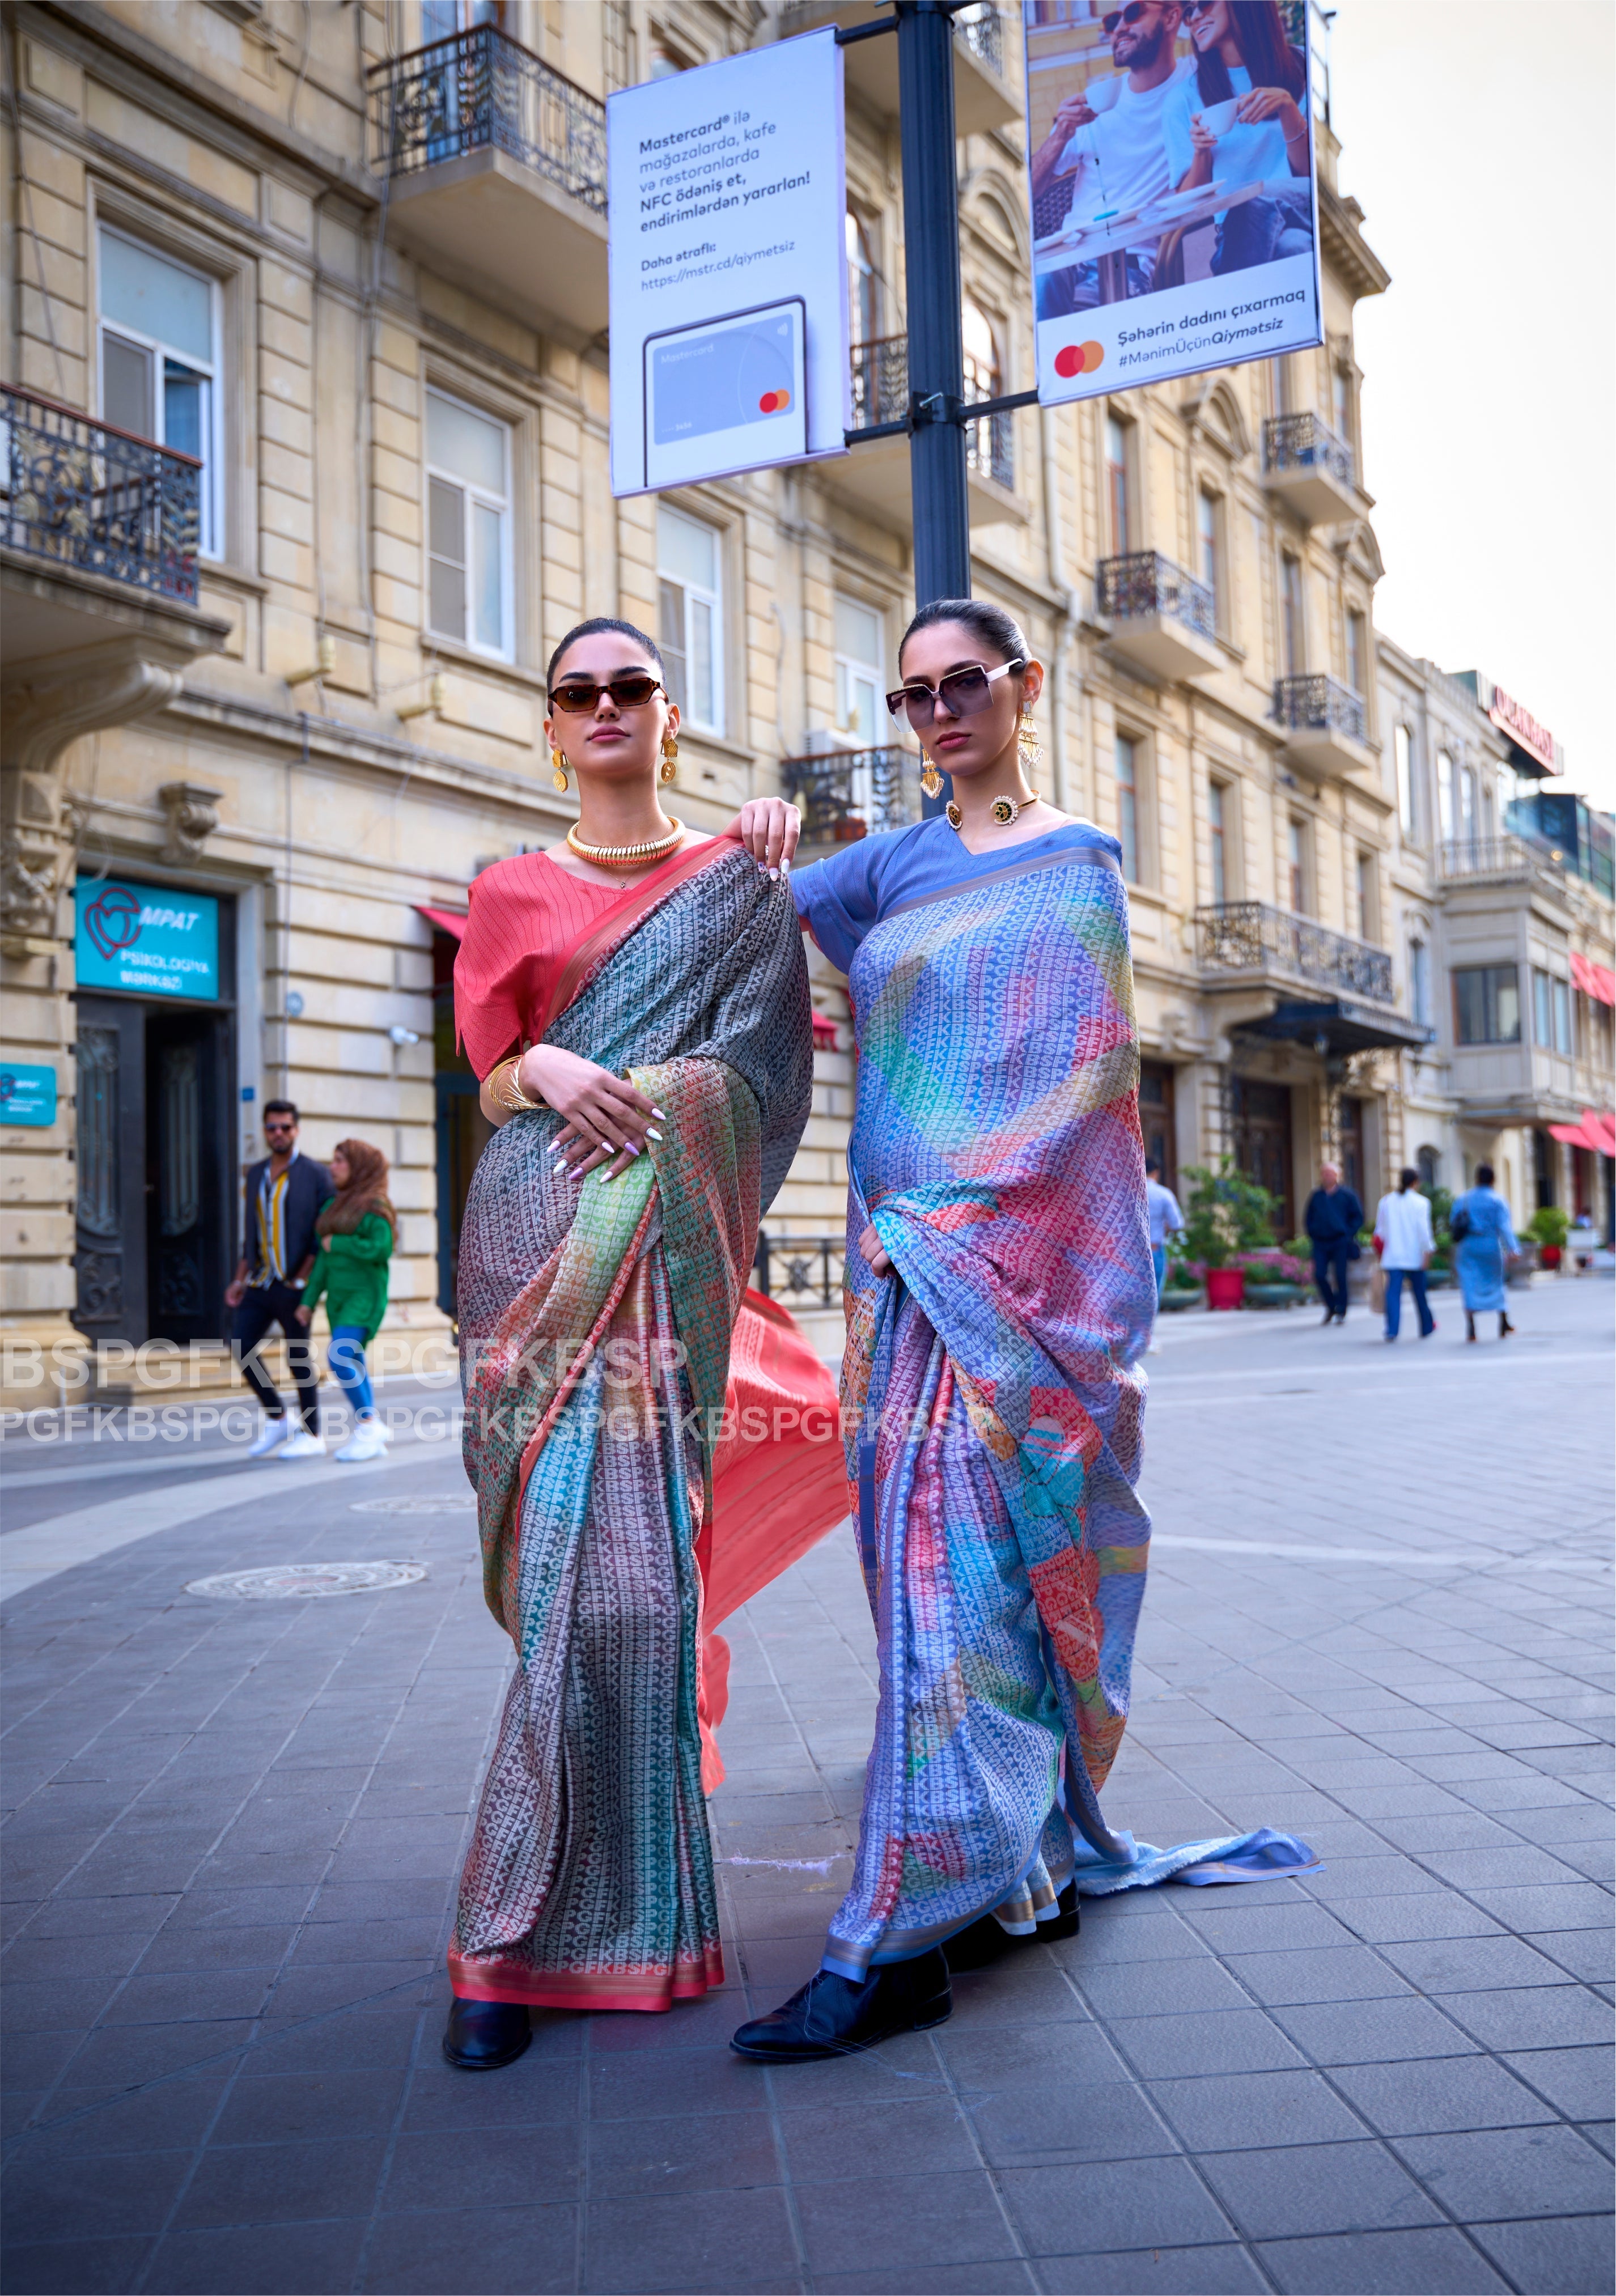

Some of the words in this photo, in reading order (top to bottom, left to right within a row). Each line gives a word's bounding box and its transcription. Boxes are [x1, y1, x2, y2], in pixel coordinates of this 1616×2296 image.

[734, 112, 750, 125] ilə
[640, 136, 740, 174] mağazalarda,
[744, 122, 776, 142] kafe
[640, 181, 656, 194] və
[660, 148, 760, 188] restoranlarda
[641, 193, 672, 213] NFC
[676, 179, 722, 202] ödəniş
[727, 173, 747, 187] et,
[641, 194, 739, 232] endirimlərdən
[743, 171, 811, 206] yararlan!
[641, 255, 672, 272] Daha
[641, 240, 795, 292] https://mstr.cd/qiymetsiz
[1118, 321, 1174, 347] Şəhərin
[1180, 309, 1226, 330] dadını
[1231, 290, 1305, 319] çıxarmaq
